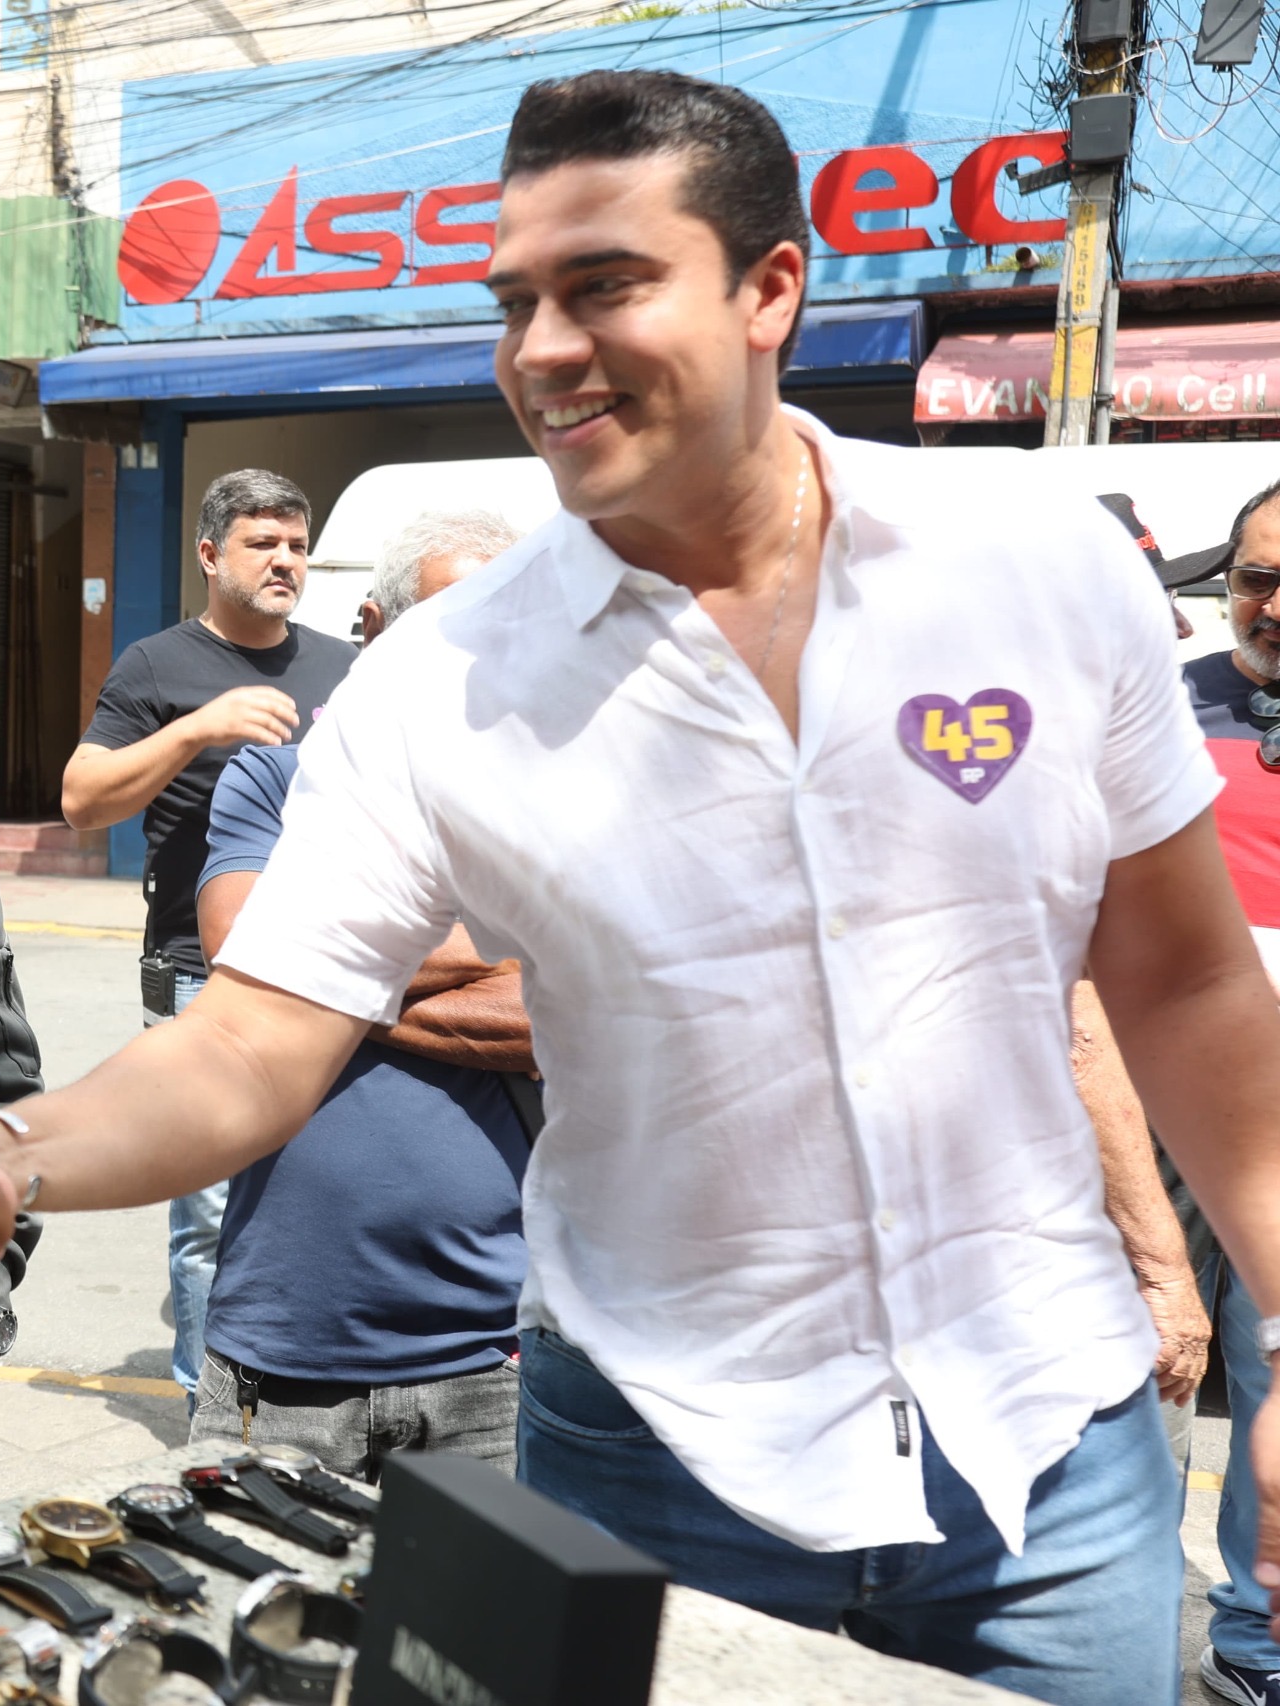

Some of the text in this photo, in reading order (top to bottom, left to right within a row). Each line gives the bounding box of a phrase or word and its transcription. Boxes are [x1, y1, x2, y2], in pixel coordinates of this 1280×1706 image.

[927, 372, 1266, 416] EVANO Cell
[923, 705, 1014, 761] 45
